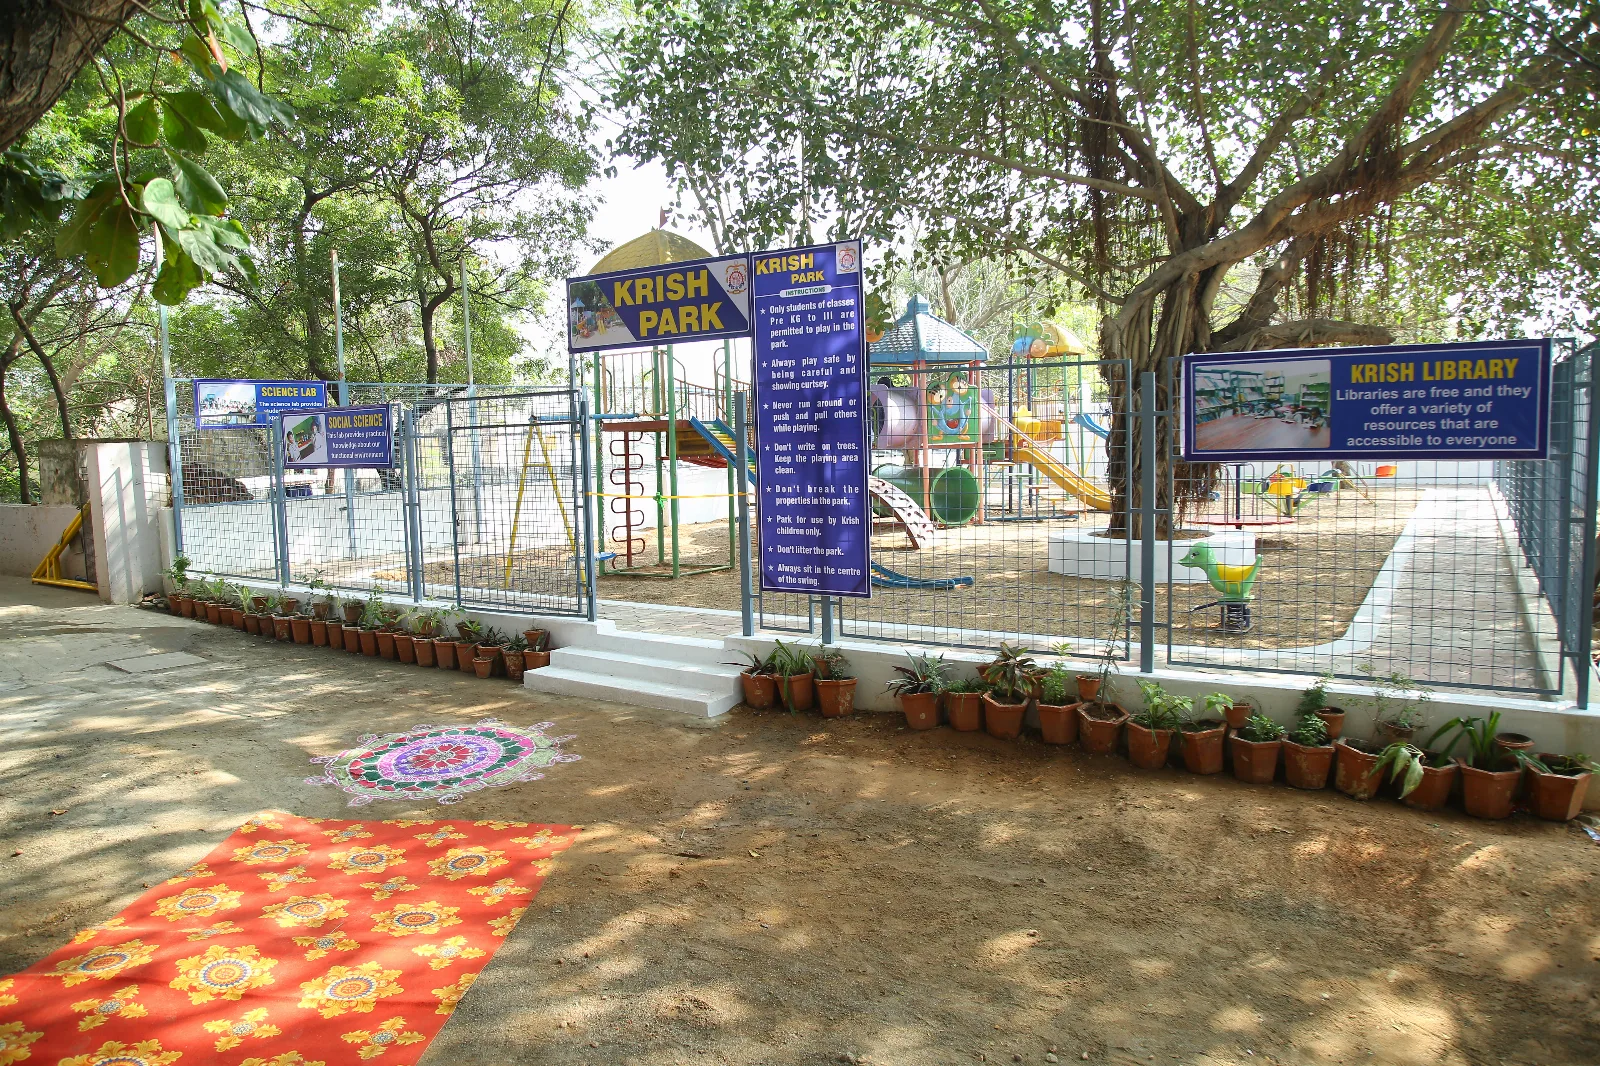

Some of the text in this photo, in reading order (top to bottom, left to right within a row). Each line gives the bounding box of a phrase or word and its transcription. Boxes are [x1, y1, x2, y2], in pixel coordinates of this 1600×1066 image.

[755, 253, 814, 275] KRISH
[791, 270, 825, 285] PARK
[613, 269, 709, 308] KRISH
[785, 286, 826, 297] INSTRUCTIONS
[769, 298, 855, 315] Only students of classes
[639, 302, 724, 337] PARK
[770, 317, 784, 326] Pre
[790, 315, 801, 324] KG
[808, 313, 816, 322] to
[840, 310, 855, 319] are
[770, 321, 855, 339] permitted to play in the
[770, 339, 789, 351] park.
[771, 353, 856, 369] Always play safe by
[771, 365, 856, 380] being careful and
[1351, 358, 1519, 384] KRISH LIBRARY
[261, 387, 317, 397] SCIENCE LAB
[771, 379, 829, 392] showing curtsey.
[1336, 384, 1532, 401] Libraries are free and they
[772, 397, 857, 410] Never run around or
[1370, 401, 1493, 416] offer a variety of
[328, 413, 383, 429] SOCIAL SCIENCE
[773, 409, 858, 423] push and pull others
[773, 422, 820, 434] while playing.
[1363, 418, 1499, 431] resources that are
[774, 442, 792, 452] Don't
[797, 442, 816, 451] write
[836, 441, 859, 450] trees.
[1347, 434, 1517, 448] accessible to everyone
[774, 453, 859, 464] Keep the playing area
[774, 465, 796, 475] clean.
[775, 484, 860, 494] Don't break the
[775, 496, 851, 507] properties in the park.
[776, 514, 860, 526] Park for use by Krish
[776, 526, 822, 537] children only.
[777, 544, 845, 557] Don't litter the park.
[777, 563, 861, 577] Always sit in the centre
[777, 575, 820, 587] of the swing.
